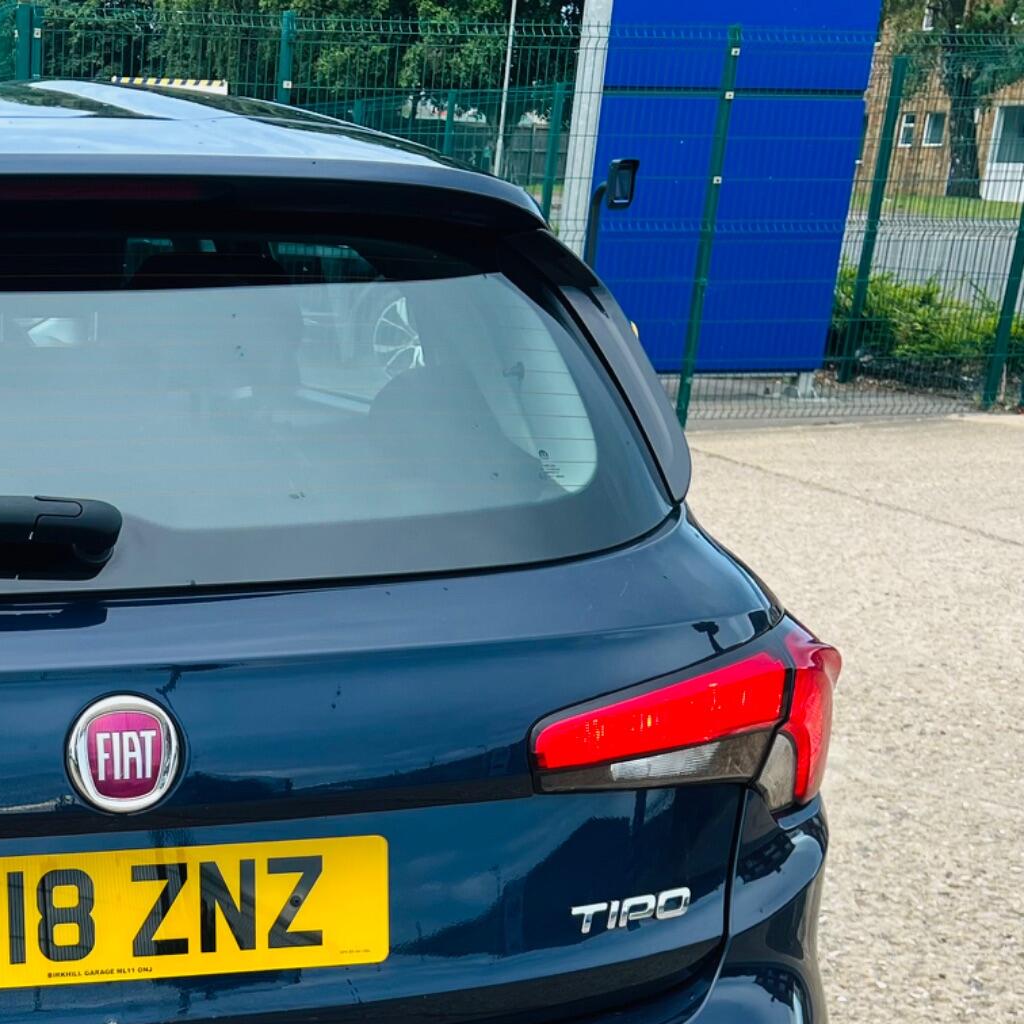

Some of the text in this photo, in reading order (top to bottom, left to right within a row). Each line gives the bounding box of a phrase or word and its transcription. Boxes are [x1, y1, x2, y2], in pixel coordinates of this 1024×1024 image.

[96, 730, 156, 780] FIAT
[131, 855, 323, 957] ZNZ
[571, 887, 691, 933] TIPO
[84, 968, 115, 976] GARAGE
